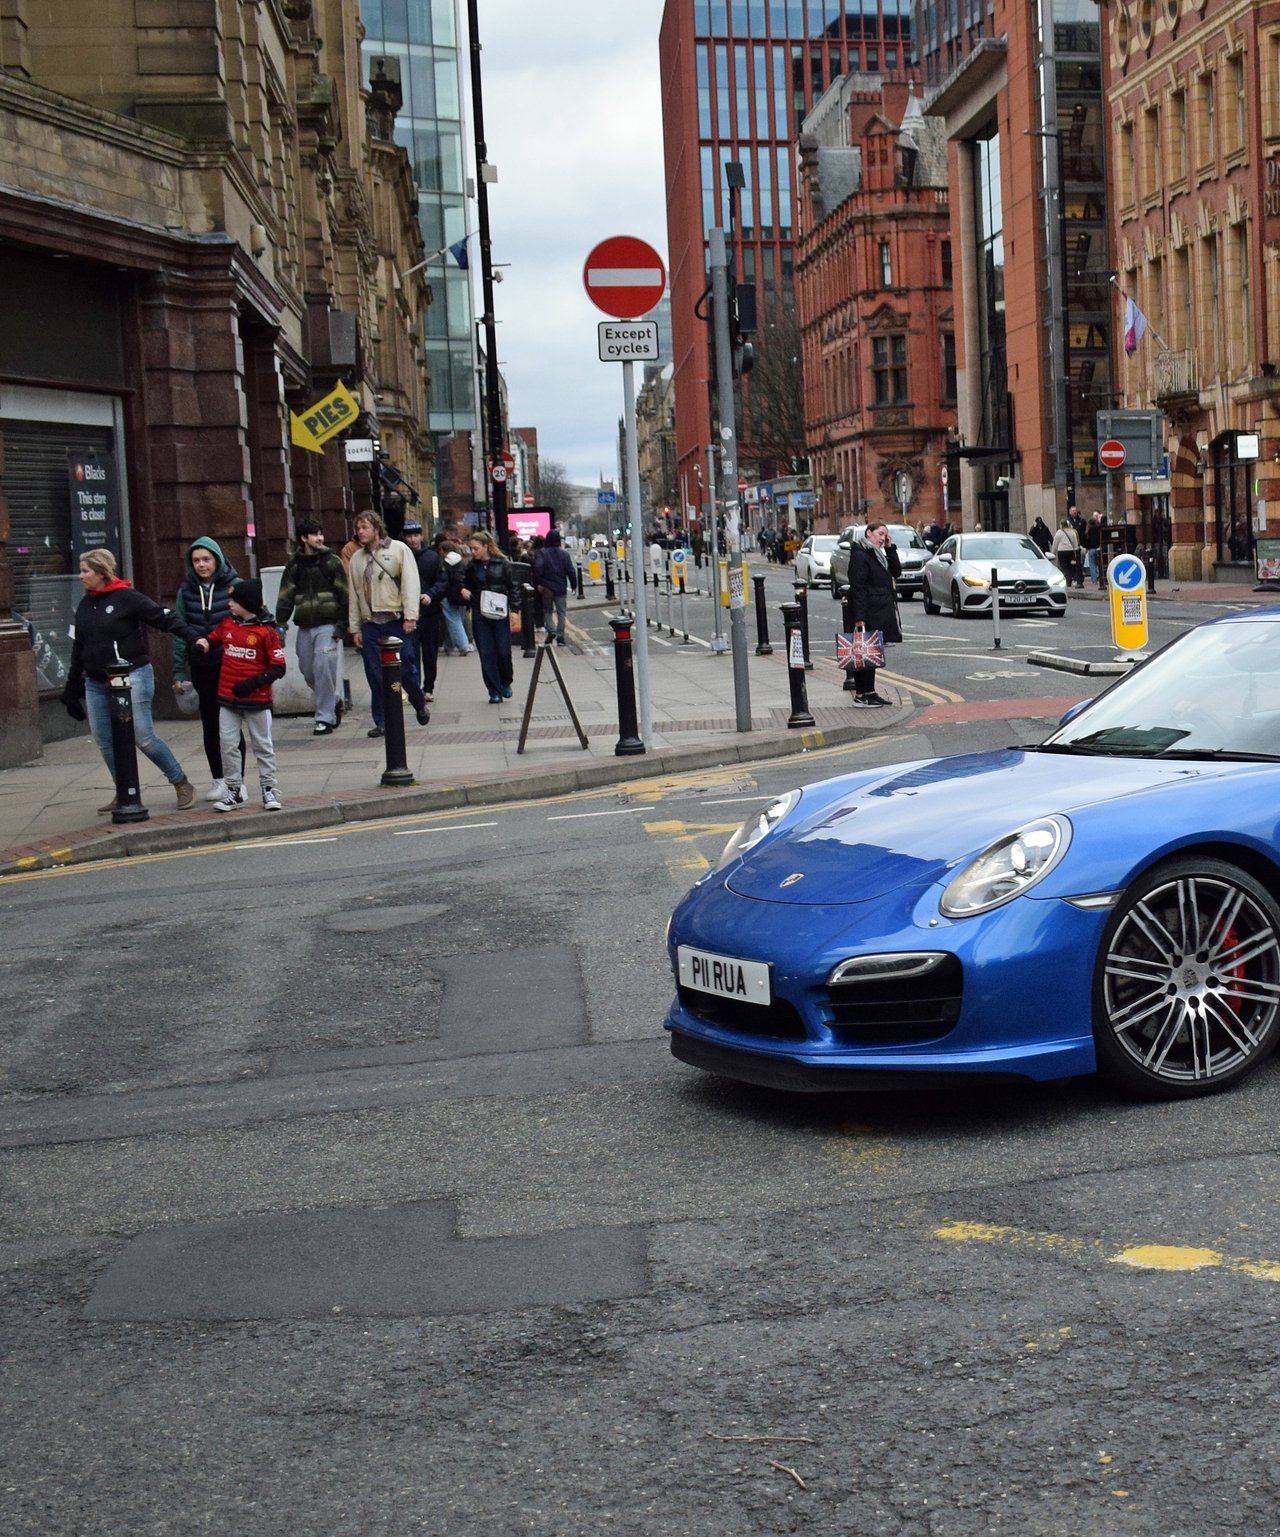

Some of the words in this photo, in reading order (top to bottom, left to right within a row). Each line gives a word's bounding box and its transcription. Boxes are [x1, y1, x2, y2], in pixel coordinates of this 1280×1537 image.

[605, 328, 652, 341] Except
[608, 342, 650, 356] cycles
[303, 397, 350, 437] PIES
[84, 464, 106, 480] Blacks
[78, 491, 93, 505] This
[93, 493, 106, 504] store
[81, 508, 89, 521] is
[88, 508, 106, 521] closed
[228, 644, 246, 652] Team
[713, 961, 747, 995] RUA
